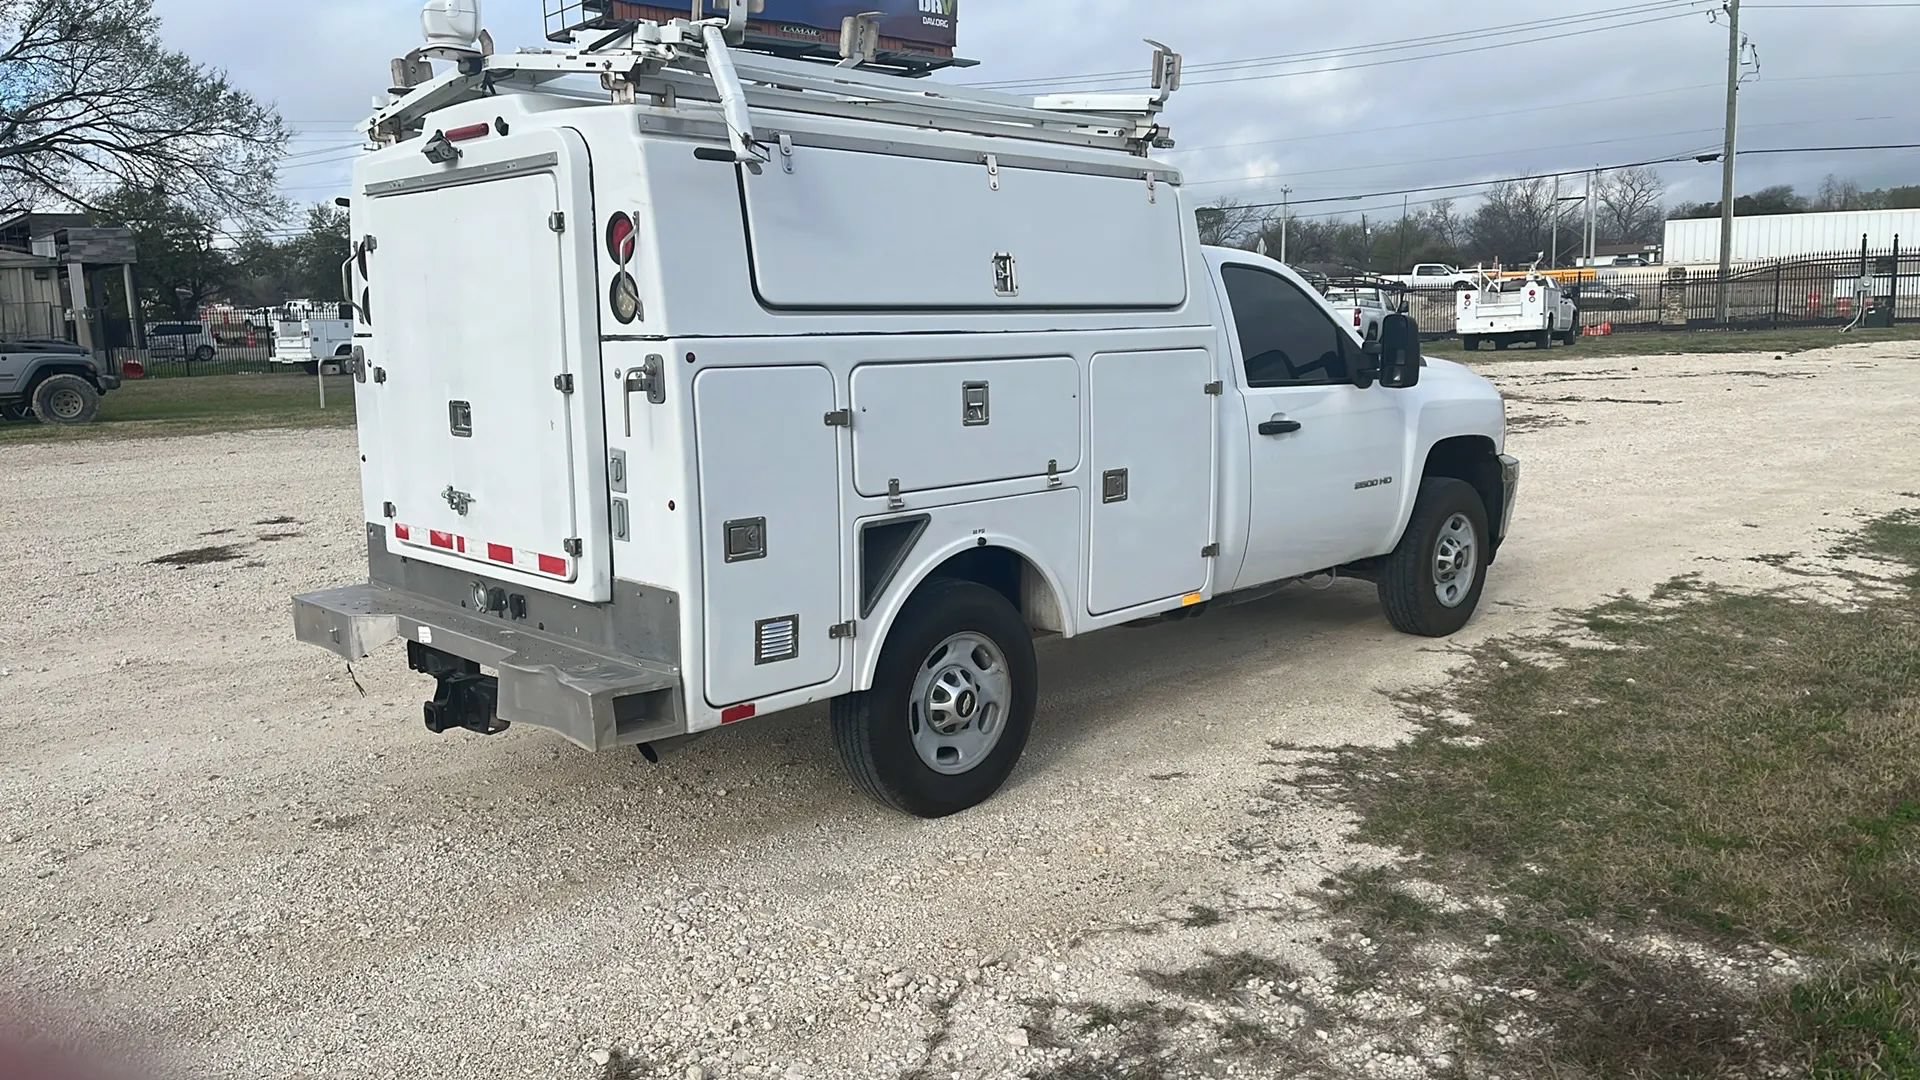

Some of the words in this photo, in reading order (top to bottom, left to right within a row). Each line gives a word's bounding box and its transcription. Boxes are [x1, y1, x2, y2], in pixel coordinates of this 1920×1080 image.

[922, 16, 949, 28] DAV.ORG
[783, 25, 817, 37] LAMAR
[1354, 479, 1379, 490] 2500
[1379, 476, 1392, 486] HD
